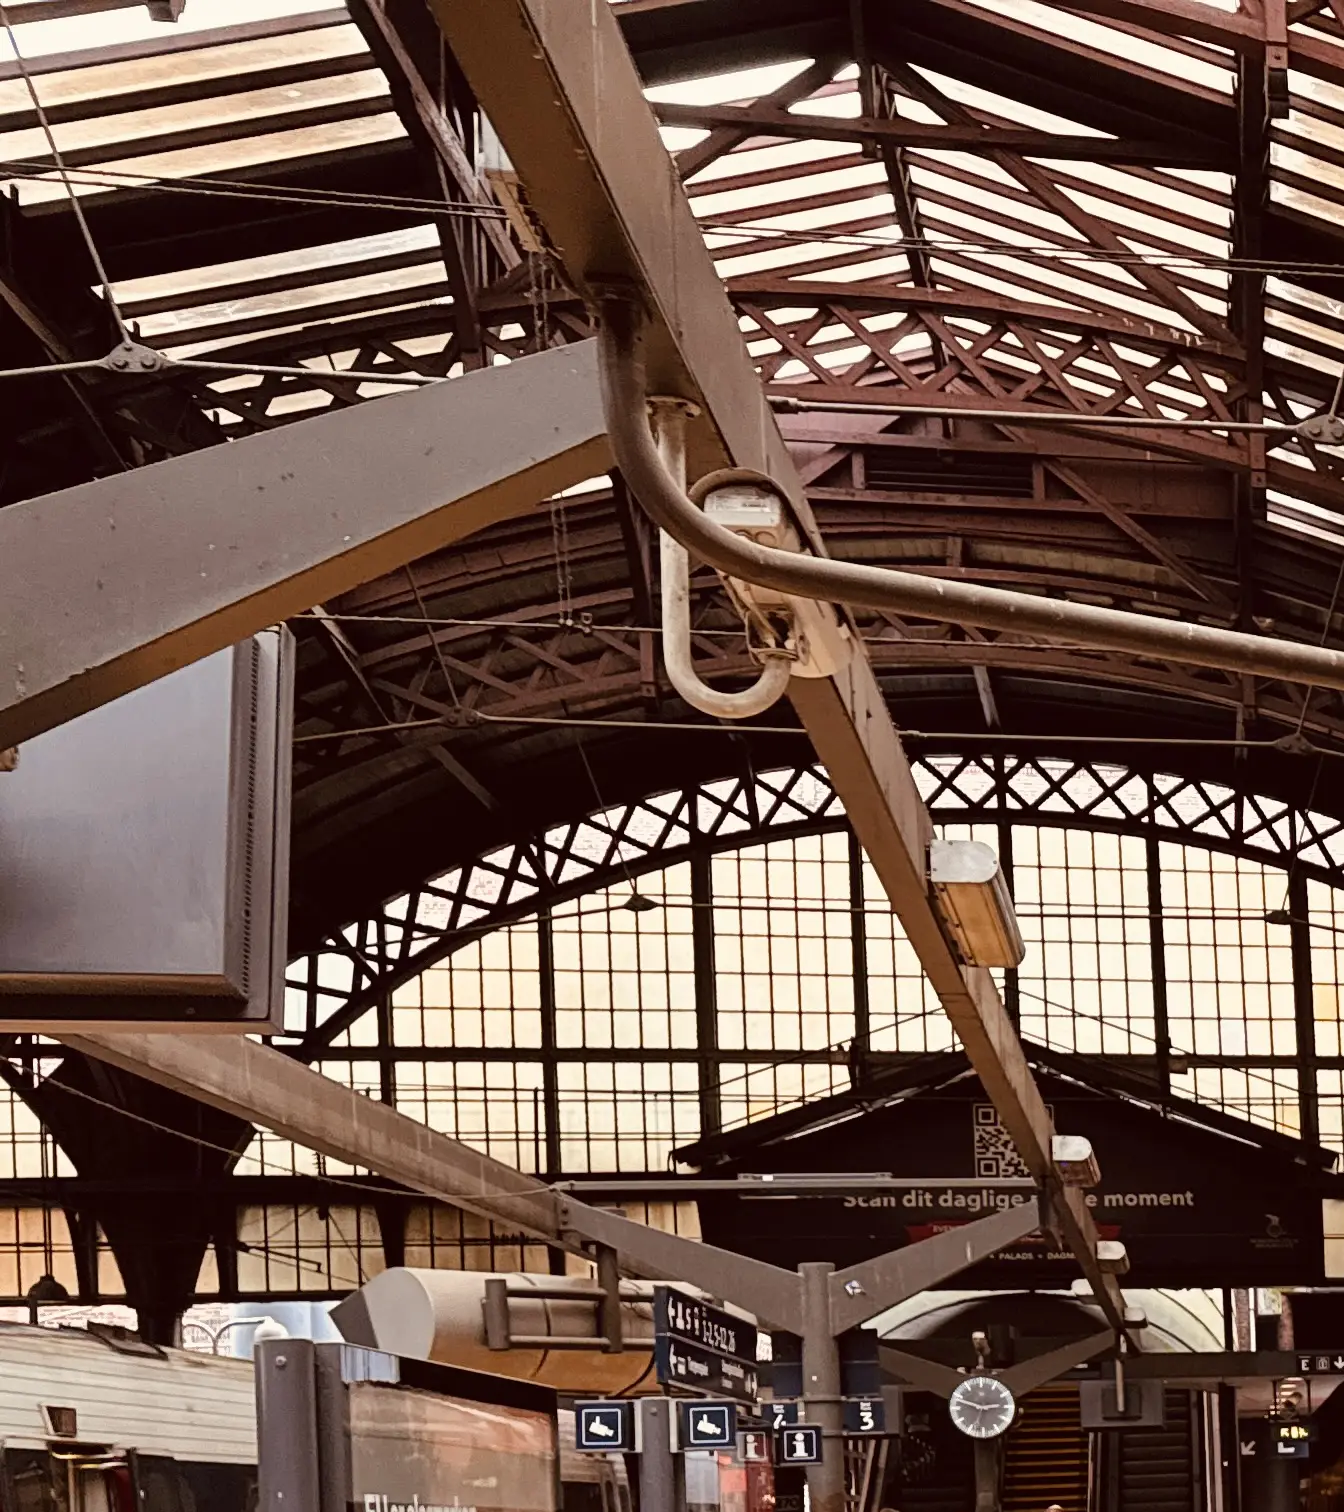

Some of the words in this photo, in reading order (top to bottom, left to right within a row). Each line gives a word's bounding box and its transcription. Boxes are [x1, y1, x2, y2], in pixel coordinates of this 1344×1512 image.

[902, 1189, 933, 1207] dit
[938, 1189, 1024, 1212] daglige
[1104, 1191, 1194, 1208] moment
[860, 1411, 874, 1430] 3
